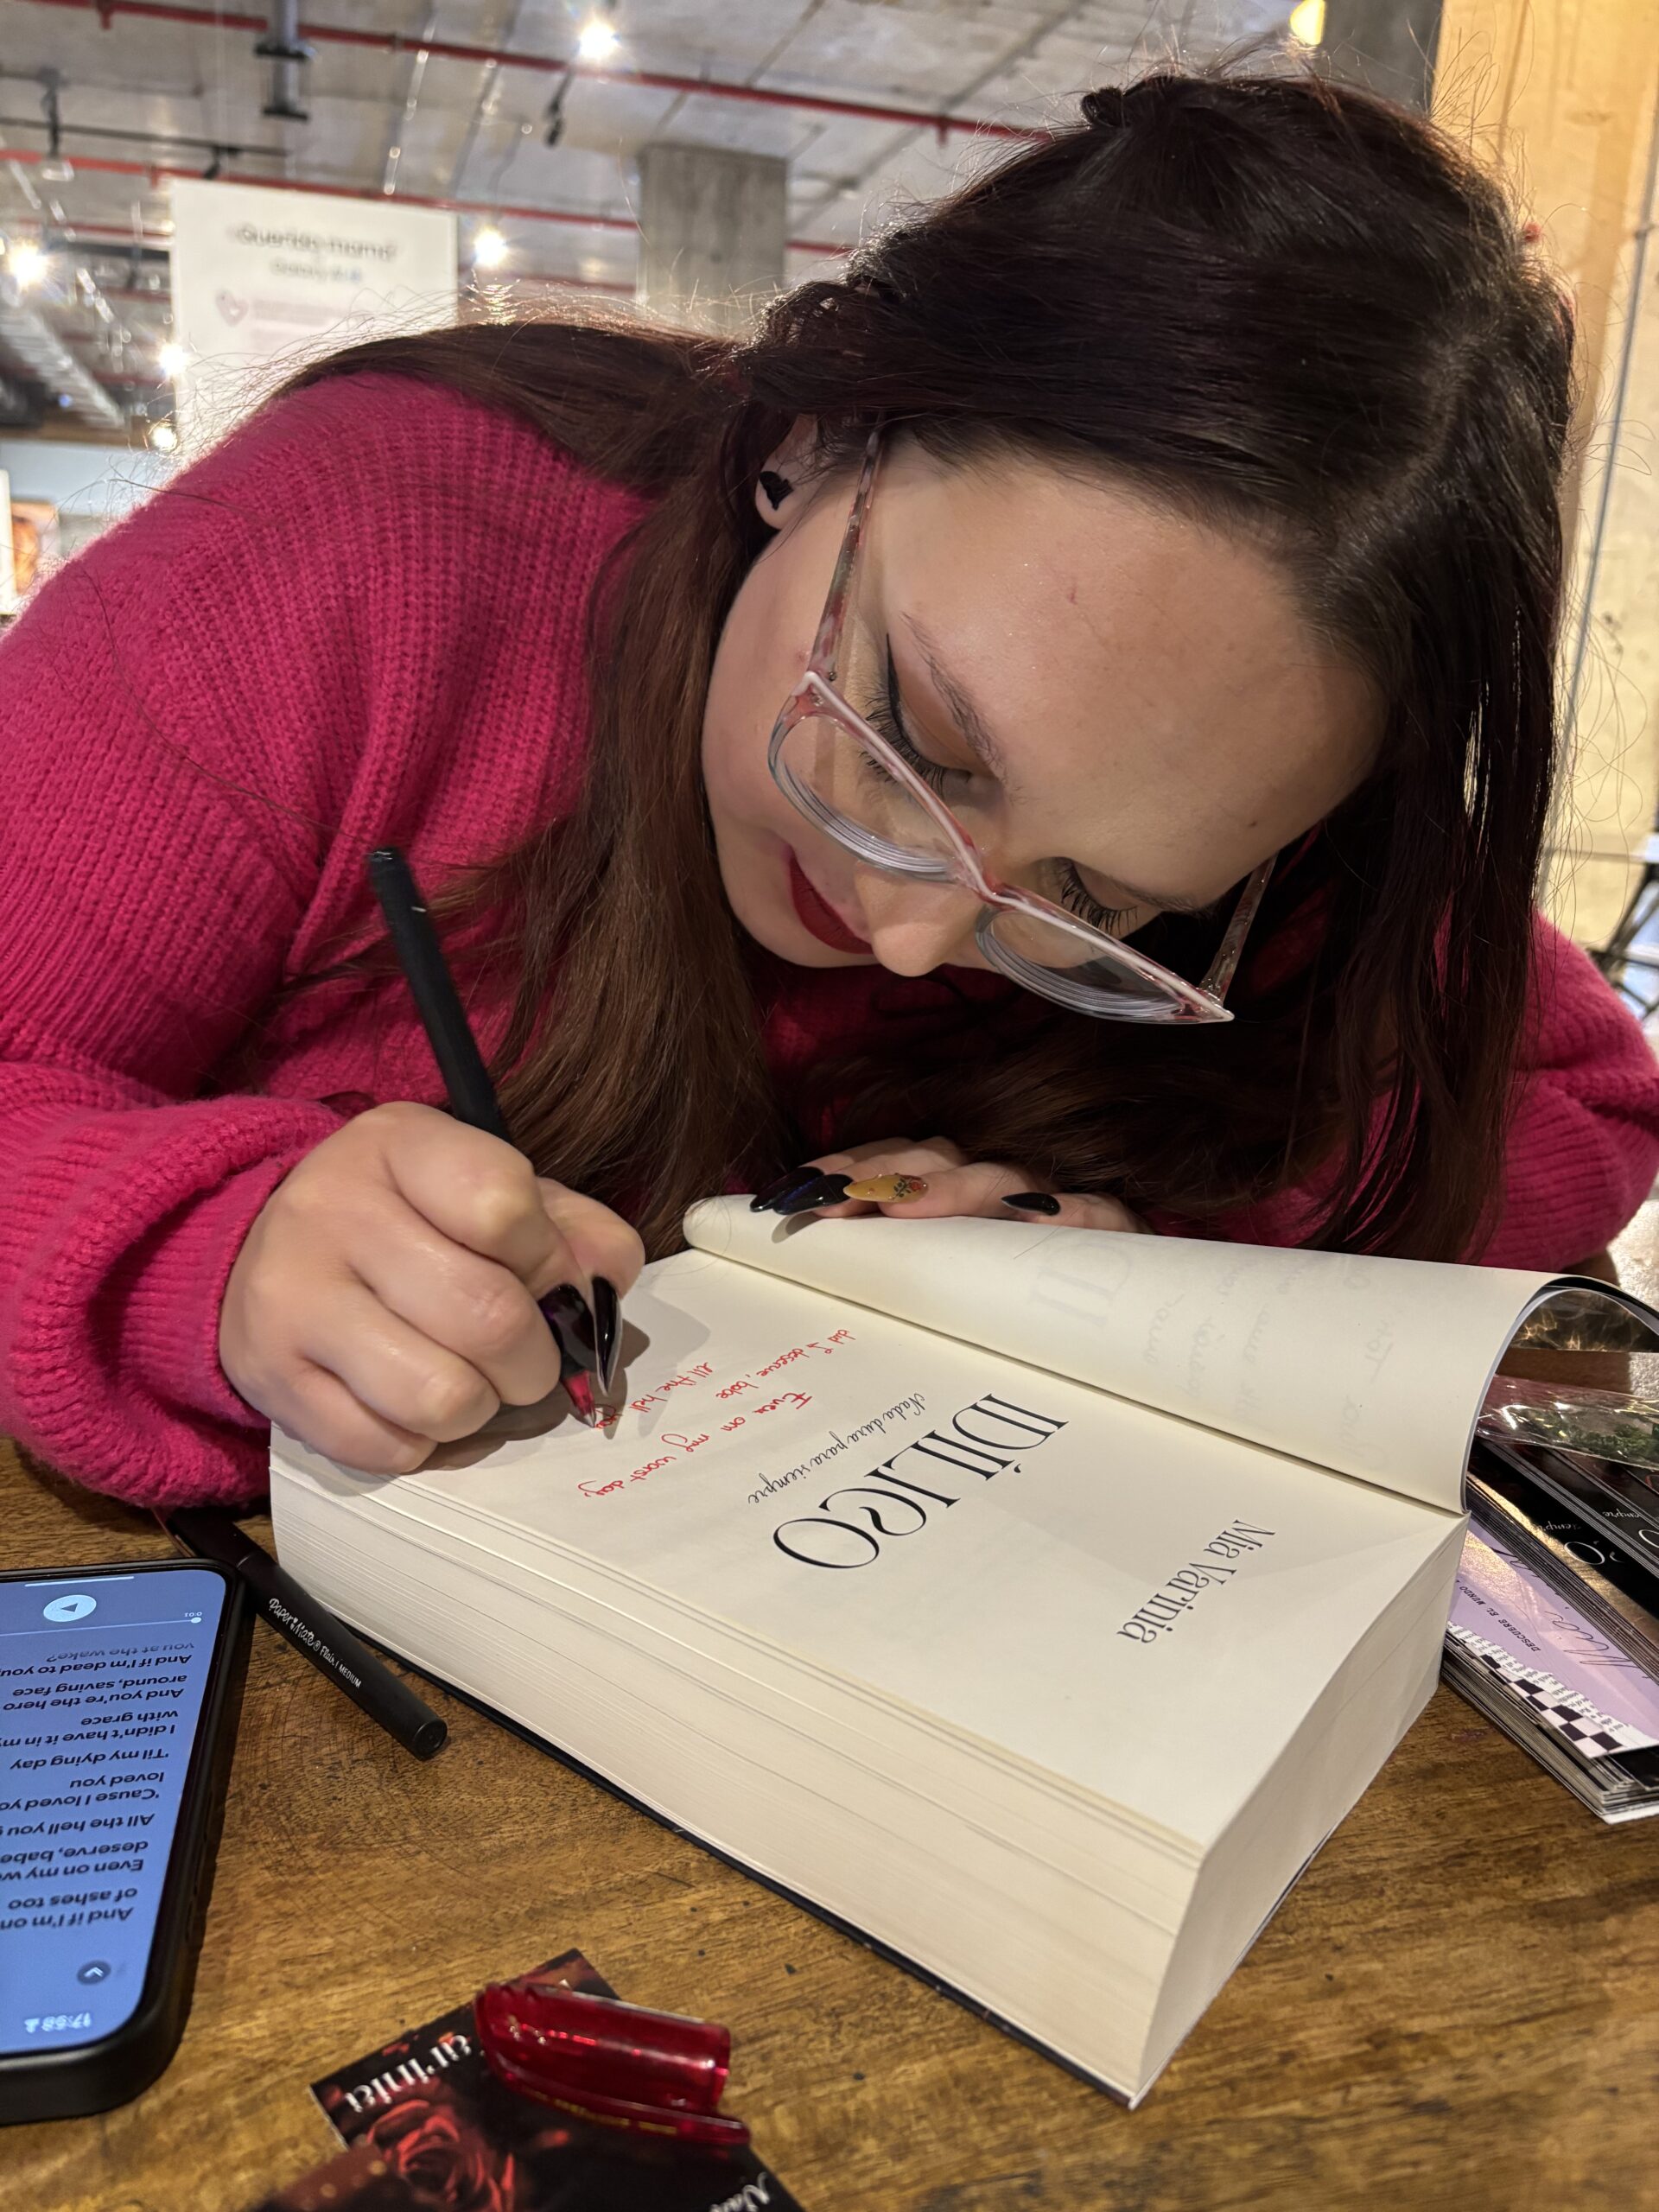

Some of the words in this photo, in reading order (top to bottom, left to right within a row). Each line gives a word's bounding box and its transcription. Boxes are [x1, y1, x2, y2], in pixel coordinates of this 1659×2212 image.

[827, 1328, 856, 1345] did
[715, 1379, 759, 1401] babe
[628, 1394, 668, 1413] hell
[882, 1392, 925, 1422] Nada
[845, 1417, 884, 1444] dura
[660, 1433, 709, 1453] my
[810, 1431, 849, 1467] para
[629, 1456, 677, 1483] worst
[747, 1464, 810, 1504] siempre
[772, 1394, 1069, 1569] IDÍLICO
[1203, 1519, 1276, 1559] Mia
[1116, 1563, 1237, 1644] Varinia
[142, 1645, 160, 1654] at
[162, 1643, 194, 1651] you
[269, 1598, 294, 1625] Paper
[320, 1645, 336, 1667] Flair
[339, 1663, 362, 1689] MEDIUM
[45, 1649, 106, 1662] wake?
[109, 1648, 139, 1656] the
[110, 1659, 137, 1669] I'm
[139, 1657, 152, 1668] if
[155, 1655, 192, 1666] And
[37, 1666, 56, 1675] to
[60, 1662, 107, 1675] dead
[54, 1681, 116, 1693] saving
[118, 1675, 188, 1689] around,
[12, 1686, 52, 1697] face
[85, 1689, 143, 1704] you're
[145, 1688, 185, 1700] And
[3, 1700, 47, 1711] hero
[49, 1696, 81, 1707] the
[80, 1712, 133, 1726] grace
[137, 1710, 179, 1722] with
[62, 1730, 109, 1742] have
[111, 1725, 167, 1738] didn't
[169, 1725, 175, 1734] I
[24, 1736, 42, 1746] in
[44, 1735, 60, 1745] it
[50, 1751, 106, 1766] dying
[109, 1750, 140, 1761] my
[143, 1748, 169, 1759] 'Til
[10, 1758, 48, 1770] day
[69, 1775, 106, 1789] you
[110, 1772, 164, 1787] loved
[85, 1795, 92, 1805] I
[95, 1789, 160, 1802] 'Cause
[24, 1796, 82, 1811] loved
[90, 1816, 124, 1829] the
[128, 1814, 156, 1827] All
[7, 1822, 45, 1836] you
[48, 1821, 86, 1834] hell
[58, 1840, 149, 1858] deserve,
[63, 1865, 90, 1876] on
[94, 1859, 144, 1872] Even
[25, 1866, 60, 1879] my
[50, 1890, 111, 1906] ashes
[113, 1888, 138, 1903] of
[8, 1897, 44, 1910] too
[33, 1914, 65, 1928] I'm
[67, 1912, 84, 1927] if
[86, 1907, 134, 1926] And
[340, 2033, 481, 2116] arinia
